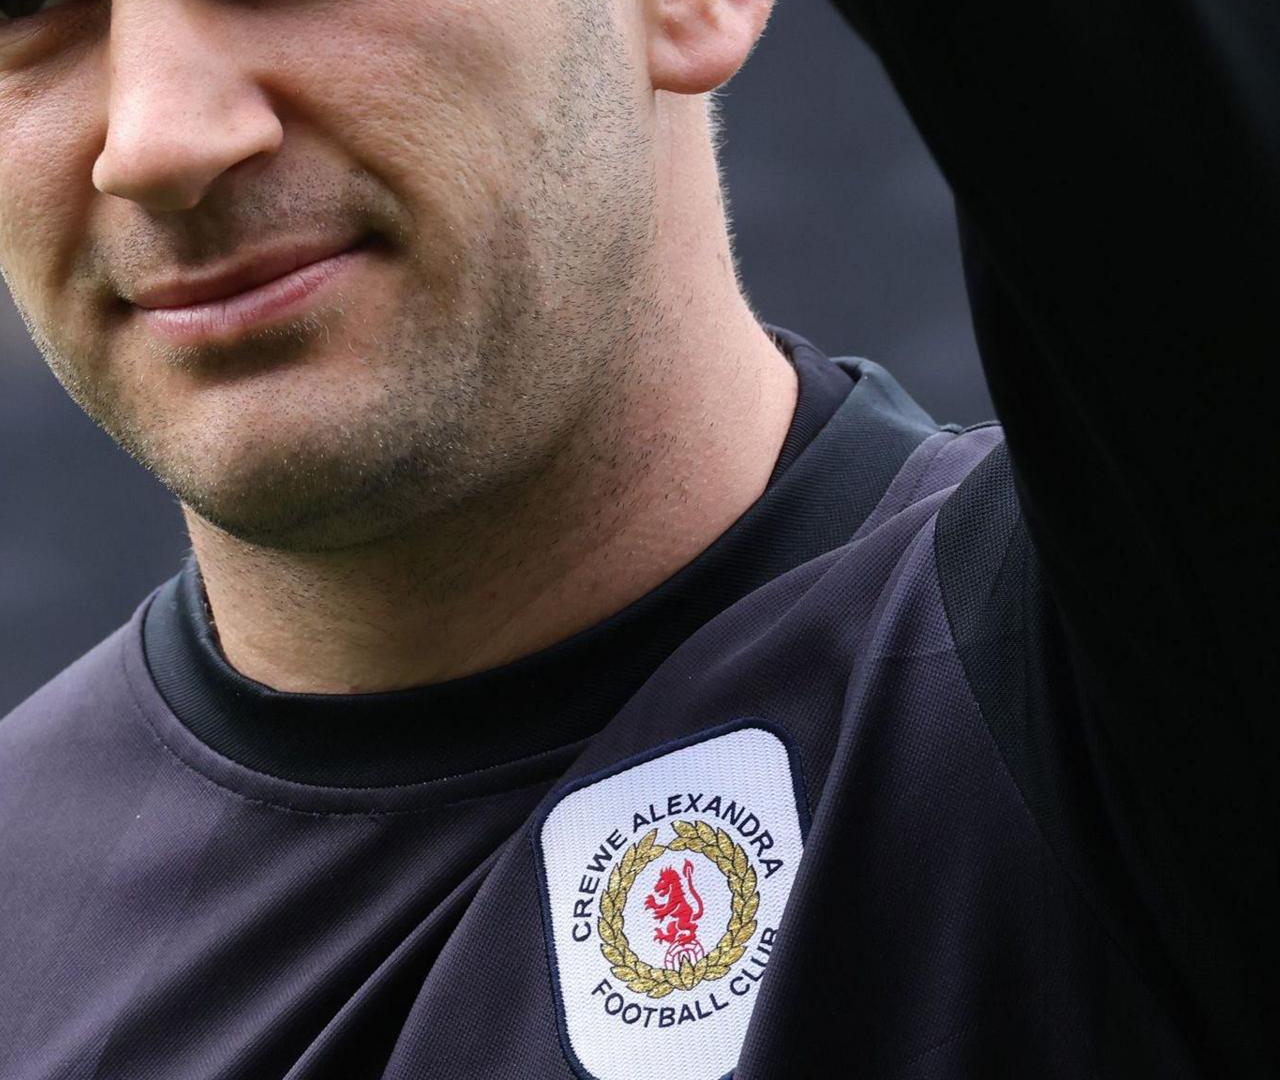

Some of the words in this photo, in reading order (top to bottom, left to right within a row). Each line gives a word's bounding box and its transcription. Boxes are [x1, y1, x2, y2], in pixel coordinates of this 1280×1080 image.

[572, 829, 628, 942] CREWE
[632, 793, 784, 879] ALEXANDRA
[591, 978, 729, 1028] FOOTBALL
